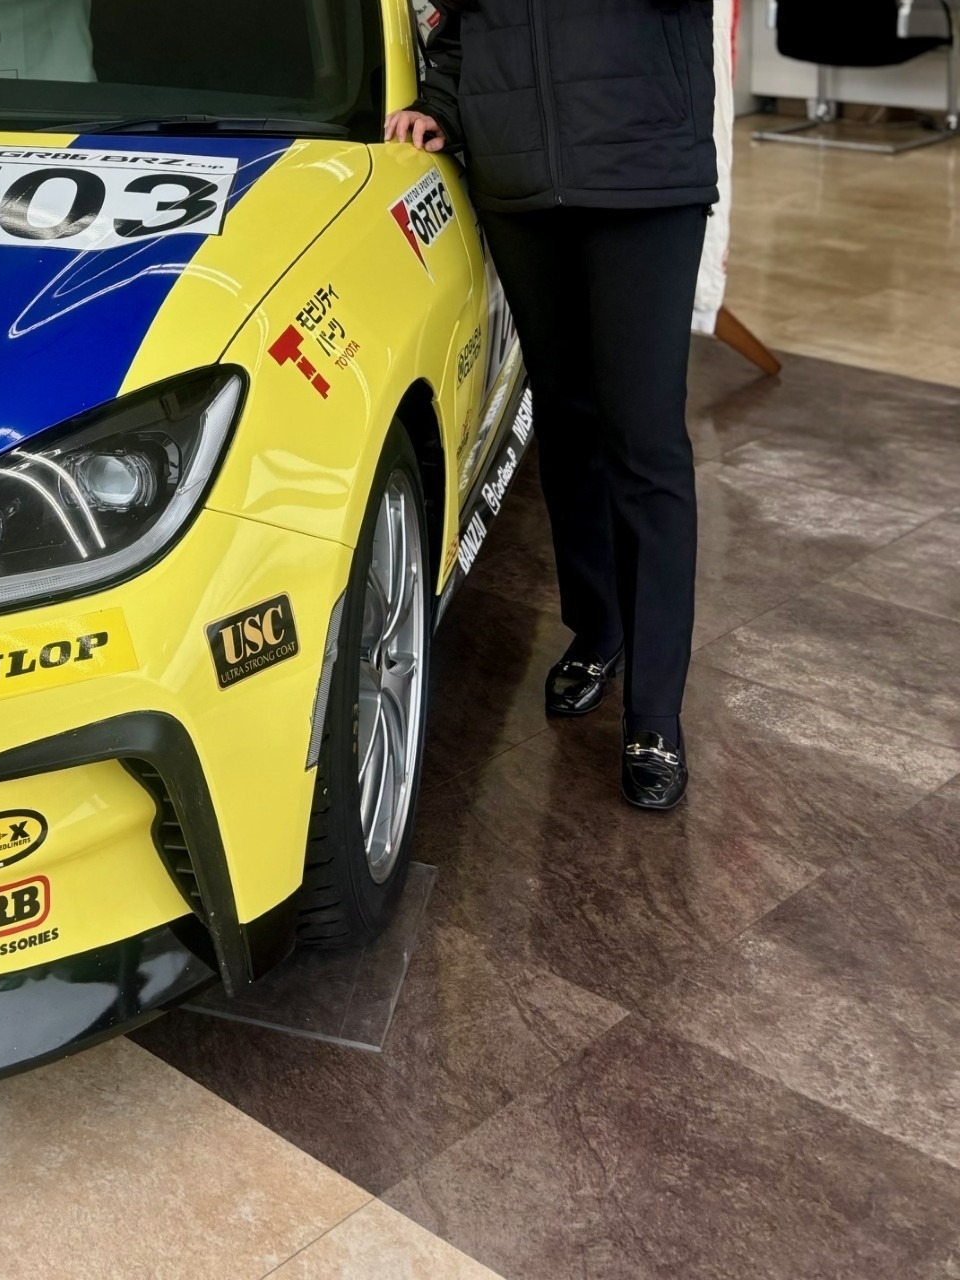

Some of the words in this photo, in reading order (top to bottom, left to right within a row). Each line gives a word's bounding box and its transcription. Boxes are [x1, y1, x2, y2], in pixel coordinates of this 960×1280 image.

[185, 161, 225, 171] Cup
[295, 282, 340, 332] モビリティ
[315, 317, 346, 358] パーツ
[334, 339, 361, 371] TOYOTA
[457, 510, 488, 577] BANZAI
[218, 604, 285, 665] USC
[220, 665, 245, 684] ULTRA
[244, 650, 276, 673] STRONG
[275, 641, 296, 658] COAT
